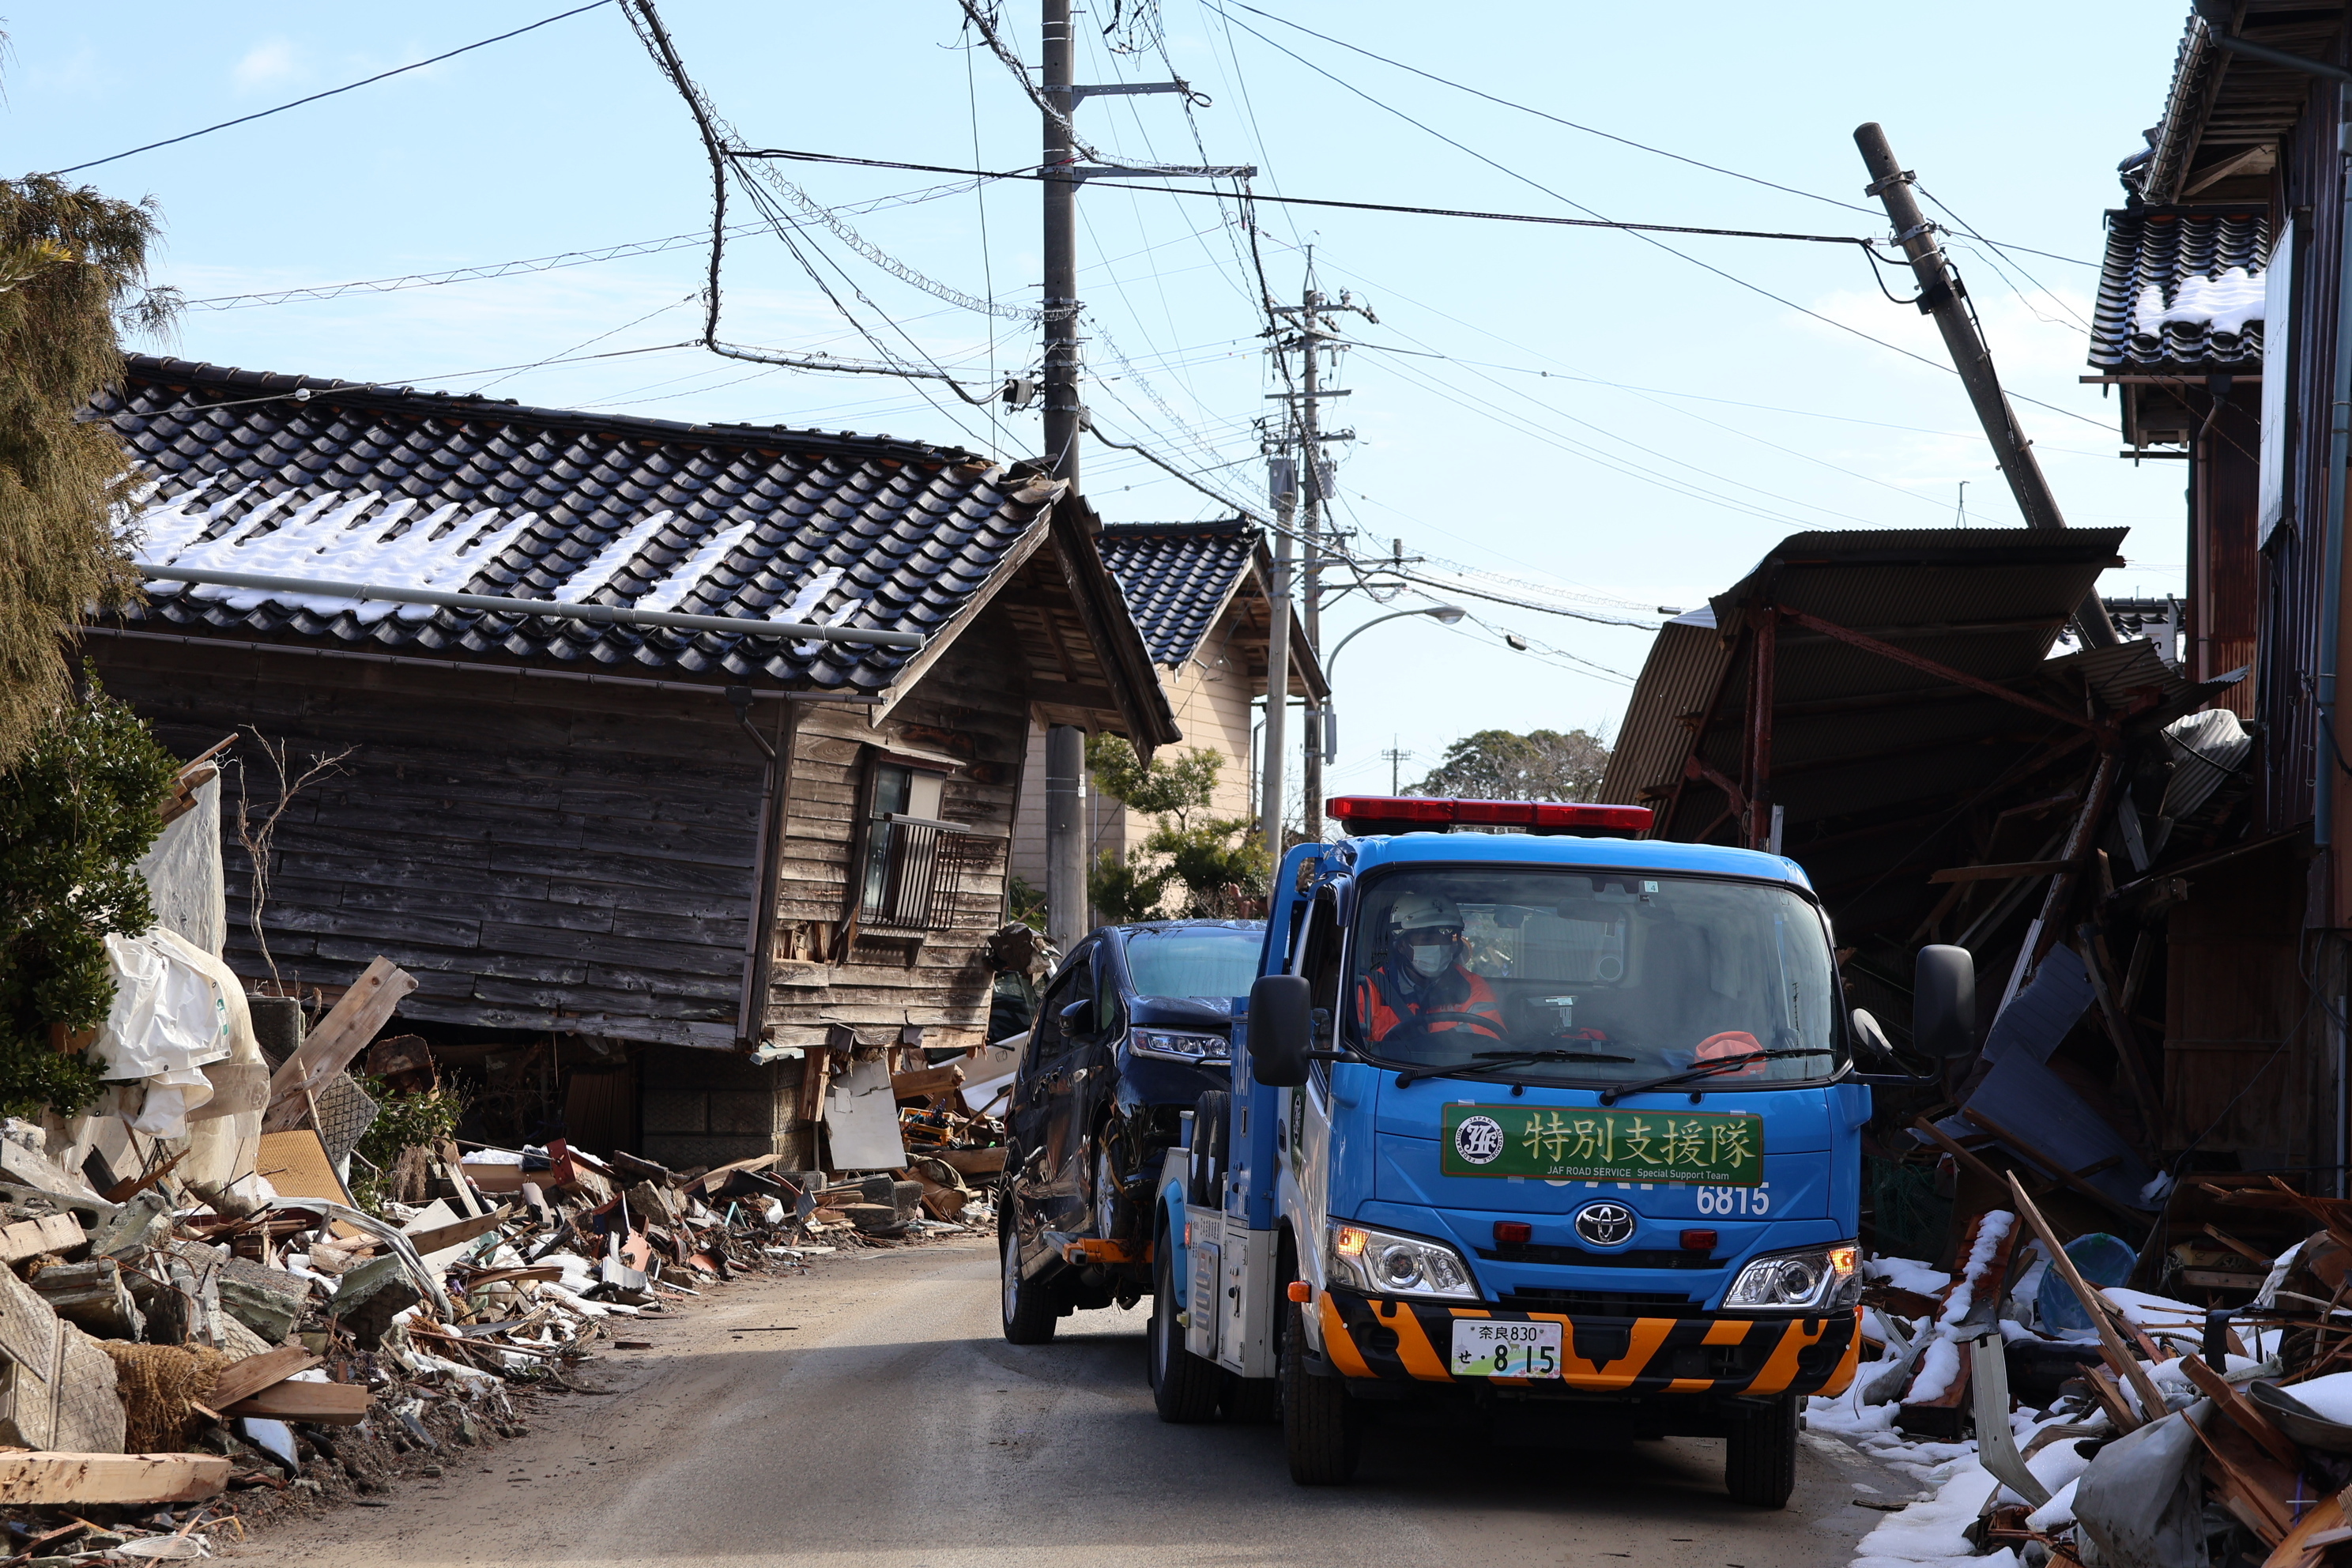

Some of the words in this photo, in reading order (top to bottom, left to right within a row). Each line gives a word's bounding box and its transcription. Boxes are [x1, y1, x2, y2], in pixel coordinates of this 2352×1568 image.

[1521, 1110, 1756, 1169] 特別支援隊
[1547, 1166, 1564, 1175] JAF
[1566, 1167, 1591, 1176] ROAD
[1593, 1167, 1631, 1177] SERVICE
[1638, 1168, 1668, 1178] Special
[1670, 1170, 1704, 1181] Support
[1706, 1171, 1729, 1180] Team
[1697, 1182, 1770, 1216] 6815
[1458, 1350, 1472, 1364] せ
